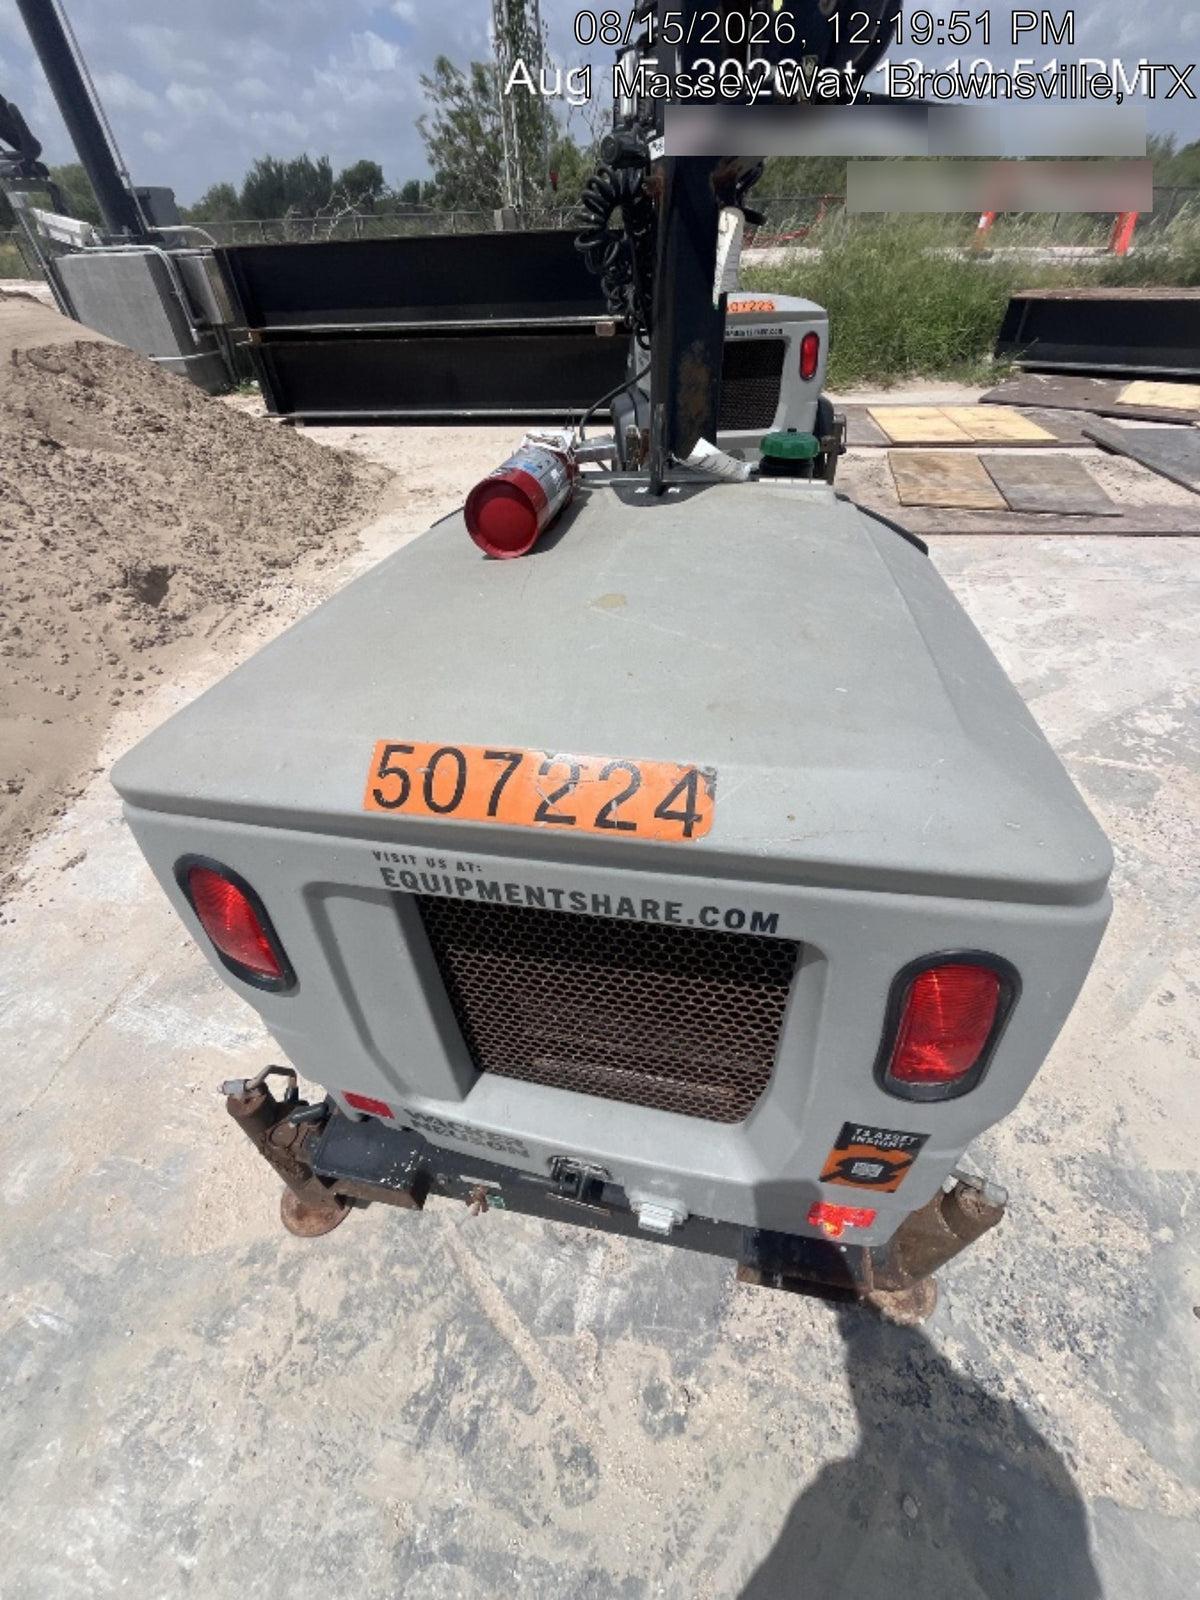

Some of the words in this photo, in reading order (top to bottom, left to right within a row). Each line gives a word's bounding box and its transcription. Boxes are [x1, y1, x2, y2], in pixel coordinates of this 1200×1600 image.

[372, 743, 704, 838] 507224
[372, 850, 417, 865] VISIT
[426, 856, 447, 869] US
[456, 861, 483, 873] AT:
[379, 866, 780, 934] EQUIPMENTSHARE.COM
